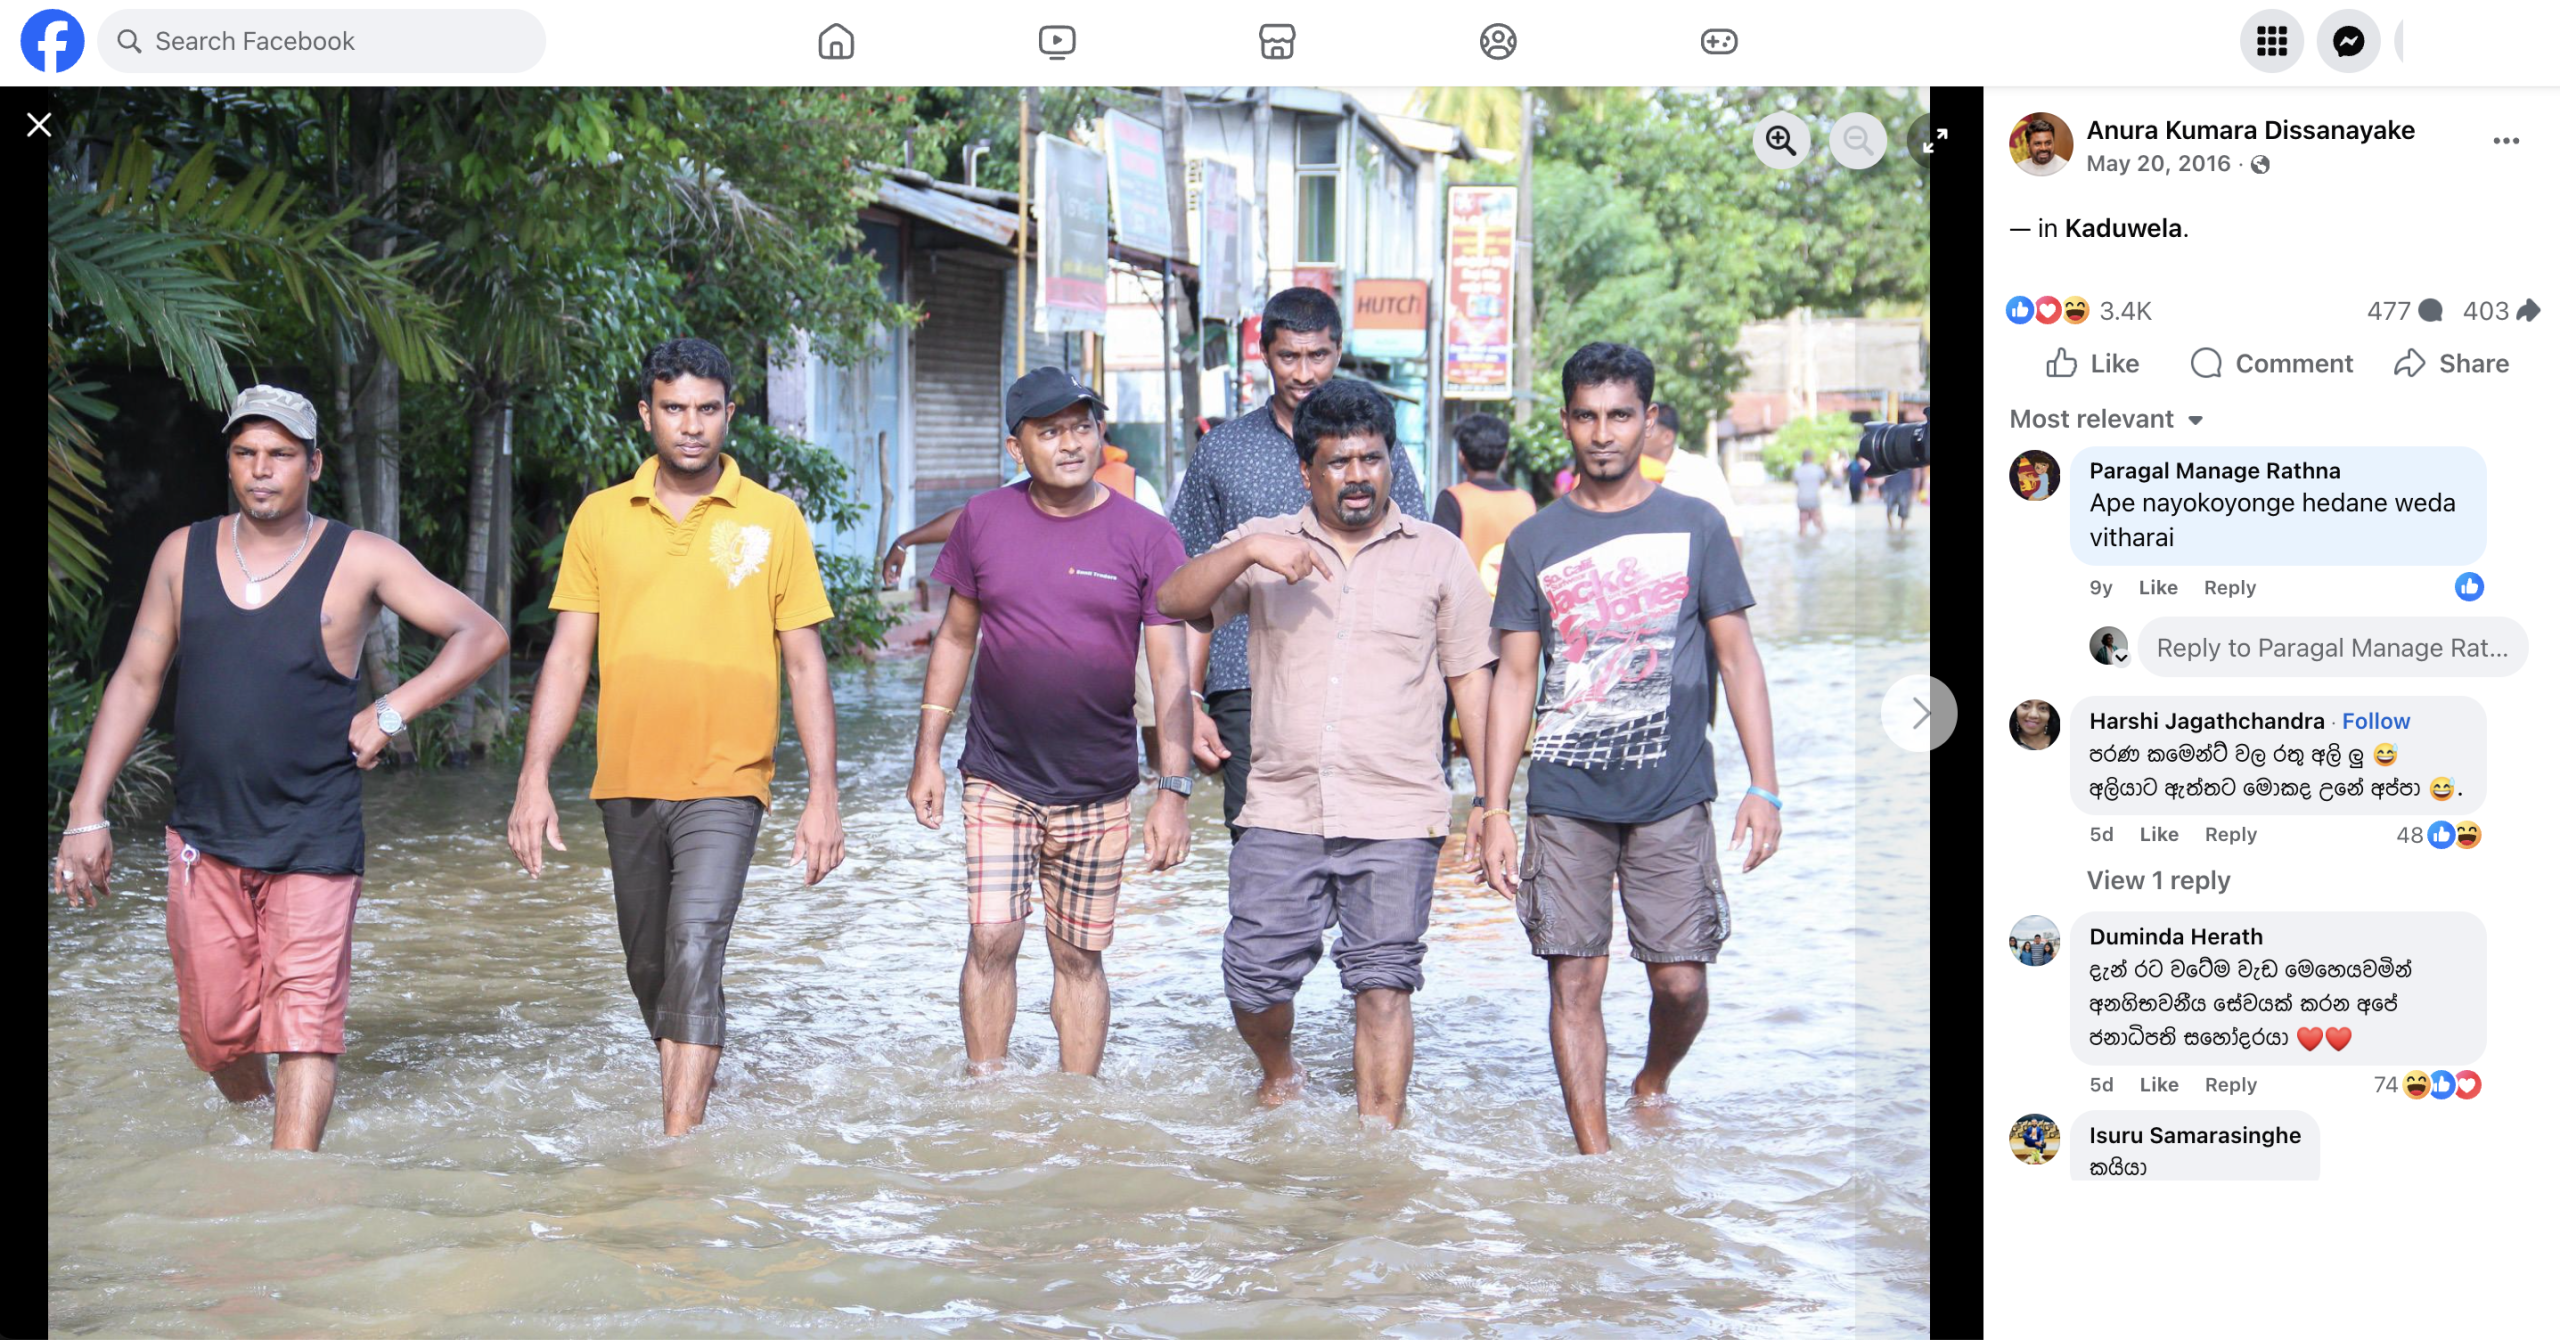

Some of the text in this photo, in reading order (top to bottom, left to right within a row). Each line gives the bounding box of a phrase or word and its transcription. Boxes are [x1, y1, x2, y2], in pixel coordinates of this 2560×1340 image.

[156, 30, 356, 51] Search Facebook
[2086, 118, 2416, 145] Anura Kumara Dissanayake
[2087, 154, 2231, 176] May 20, 2016
[2038, 217, 2058, 238] in
[2065, 217, 2189, 239] Kaduwela.
[2100, 300, 2153, 321] 3.4K
[2367, 301, 2411, 321] 477
[2463, 300, 2510, 321] 403
[2091, 352, 2140, 374] Like
[2236, 353, 2354, 374] Comment
[2439, 352, 2510, 374] Share
[2010, 408, 2175, 429] Most relevant
[2090, 461, 2341, 484] Paragal Manage Rathna
[2089, 491, 2456, 517] Ape nayokoyonge hedane weda
[2089, 526, 2174, 548] vitharai
[1546, 568, 1618, 621] Jack
[2089, 579, 2113, 599] 9y
[2139, 578, 2179, 596] Like
[2204, 579, 2257, 599] Reply
[1586, 576, 1690, 630] Jones
[2158, 637, 2221, 662] Reply
[2227, 639, 2251, 658] to
[2259, 637, 2344, 662] Paragal
[2352, 638, 2444, 662] Manage
[2090, 711, 2412, 734] Harshi Jagathchandra Follow
[2089, 743, 2141, 763] පරණ
[2146, 740, 2229, 763] කමෙන්ට්
[2234, 742, 2267, 768] වල
[2273, 743, 2305, 767] රතු
[2311, 742, 2342, 768] අලි
[2088, 776, 2421, 802] අලියාට ඇත්තට මොකද උනේ අප්පා
[2090, 826, 2114, 842] 5d
[2140, 825, 2180, 842] Like
[2205, 826, 2258, 846] Reply
[2396, 826, 2424, 844] 48
[2086, 869, 2232, 895] View 1 reply
[2090, 926, 2264, 946] Duminda Herath
[2088, 955, 2413, 983] දැන් රට වටේම වැඩ මෙහෙයවමින්
[2213, 992, 2293, 1013] සේවයක්
[2299, 992, 2351, 1013] කරන
[2356, 992, 2398, 1017] අපේ
[2088, 1023, 2289, 1050] ජනාධිපති සහෝදරයා
[2090, 1076, 2114, 1093] 5d
[2140, 1075, 2180, 1093] Like
[2205, 1076, 2258, 1096] Reply
[2374, 1075, 2399, 1093] 74
[2090, 1125, 2302, 1149] Isuru Samarasinghe
[2089, 1155, 2148, 1176] කයියා
